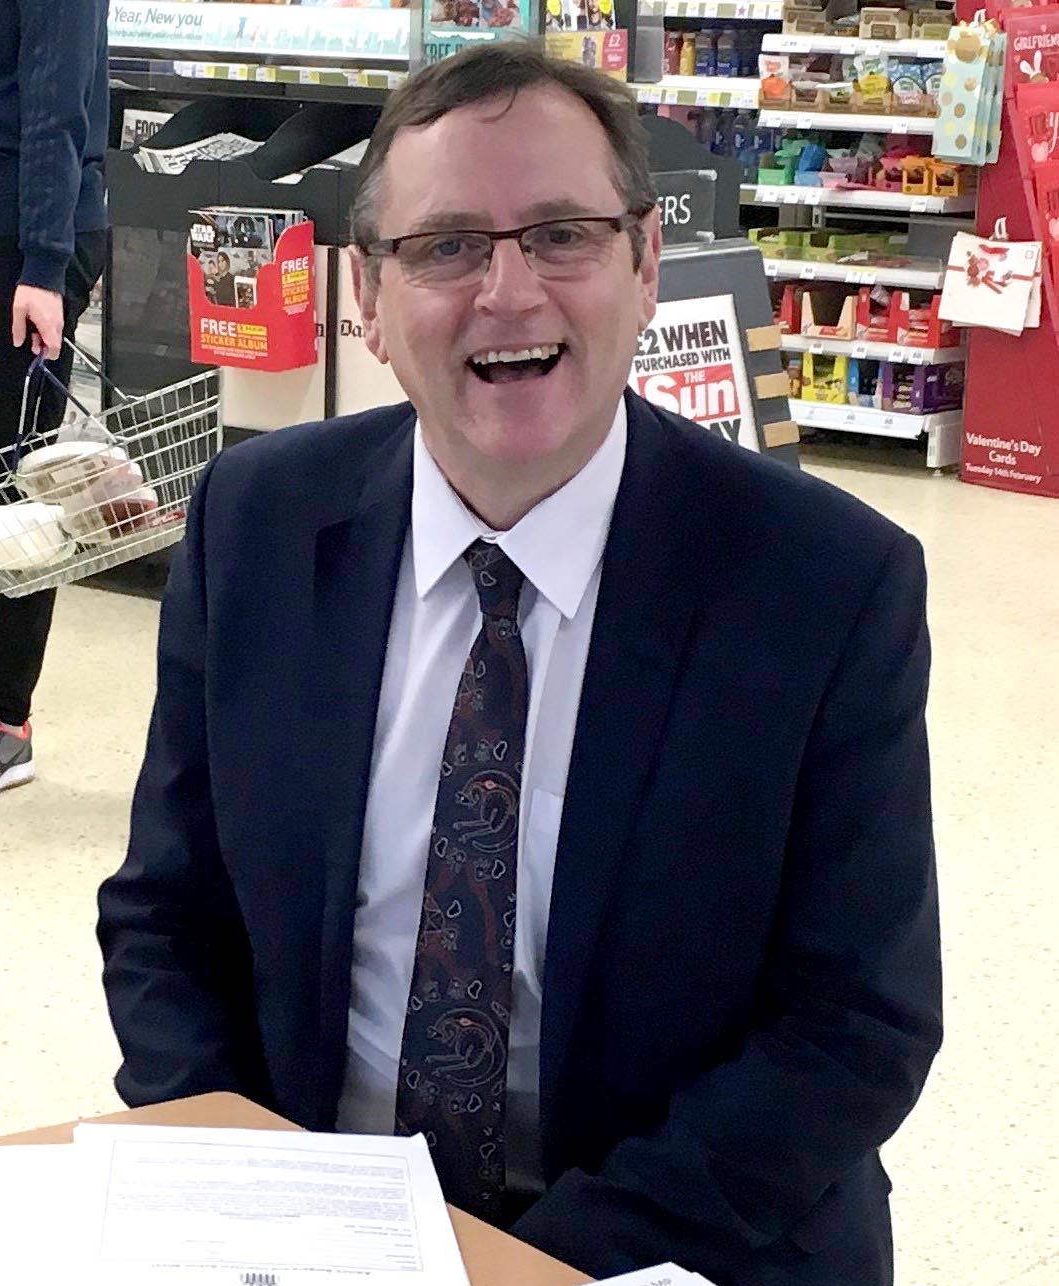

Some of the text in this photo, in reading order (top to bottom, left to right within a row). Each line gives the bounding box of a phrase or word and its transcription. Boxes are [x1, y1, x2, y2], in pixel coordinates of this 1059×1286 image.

[114, 6, 203, 28] Year, New you
[281, 256, 309, 274] FREE
[201, 317, 237, 337] FREE
[340, 319, 365, 338] Da
[660, 319, 729, 352] WHEN
[201, 334, 268, 352] STICKER ALBUM
[635, 347, 732, 373] PURCHASED WITH
[684, 370, 706, 384] THE
[644, 375, 736, 419] Sun
[966, 432, 1041, 456] Valentine's Day
[988, 450, 1017, 465] Cards
[965, 463, 993, 477] Tuesday
[1010, 470, 1042, 484] February
